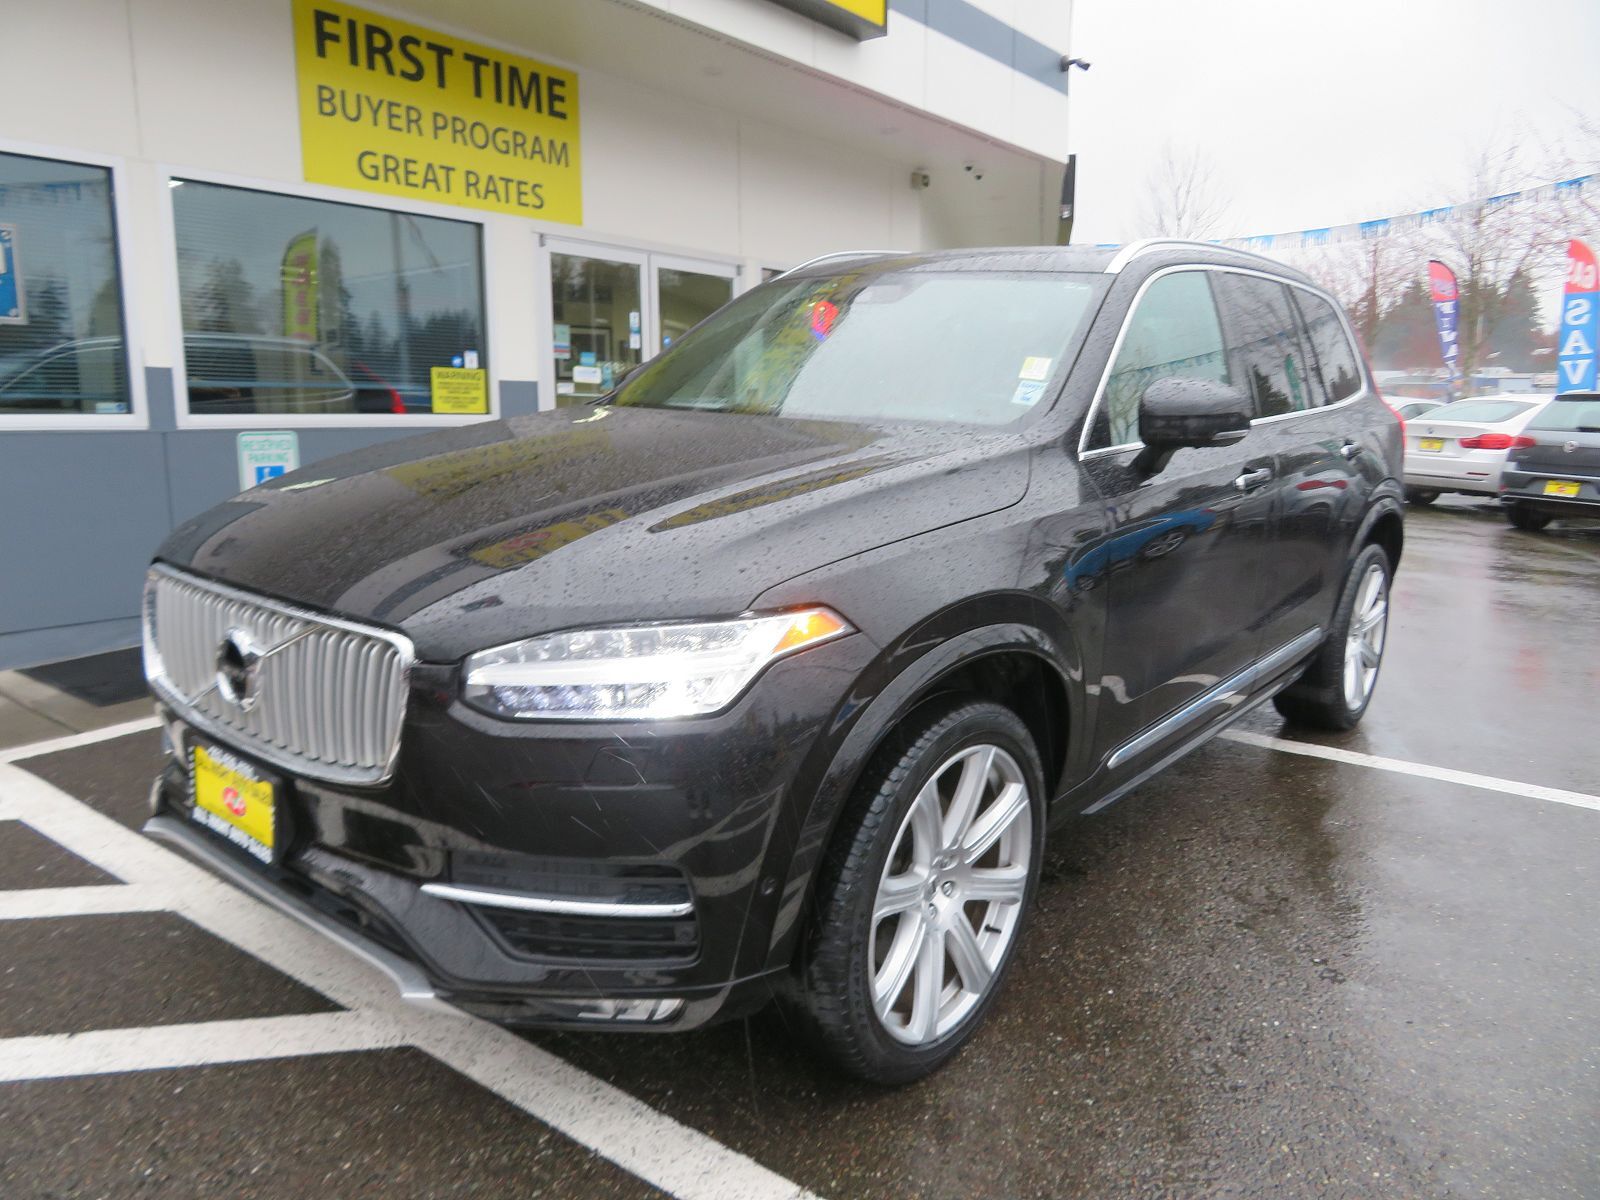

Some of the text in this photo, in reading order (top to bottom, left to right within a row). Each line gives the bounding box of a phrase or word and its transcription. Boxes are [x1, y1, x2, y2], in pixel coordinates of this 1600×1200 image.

[314, 9, 567, 120] FIRST TIME
[317, 85, 570, 168] BUYER PROGRAM
[357, 150, 544, 209] GREAT RATES
